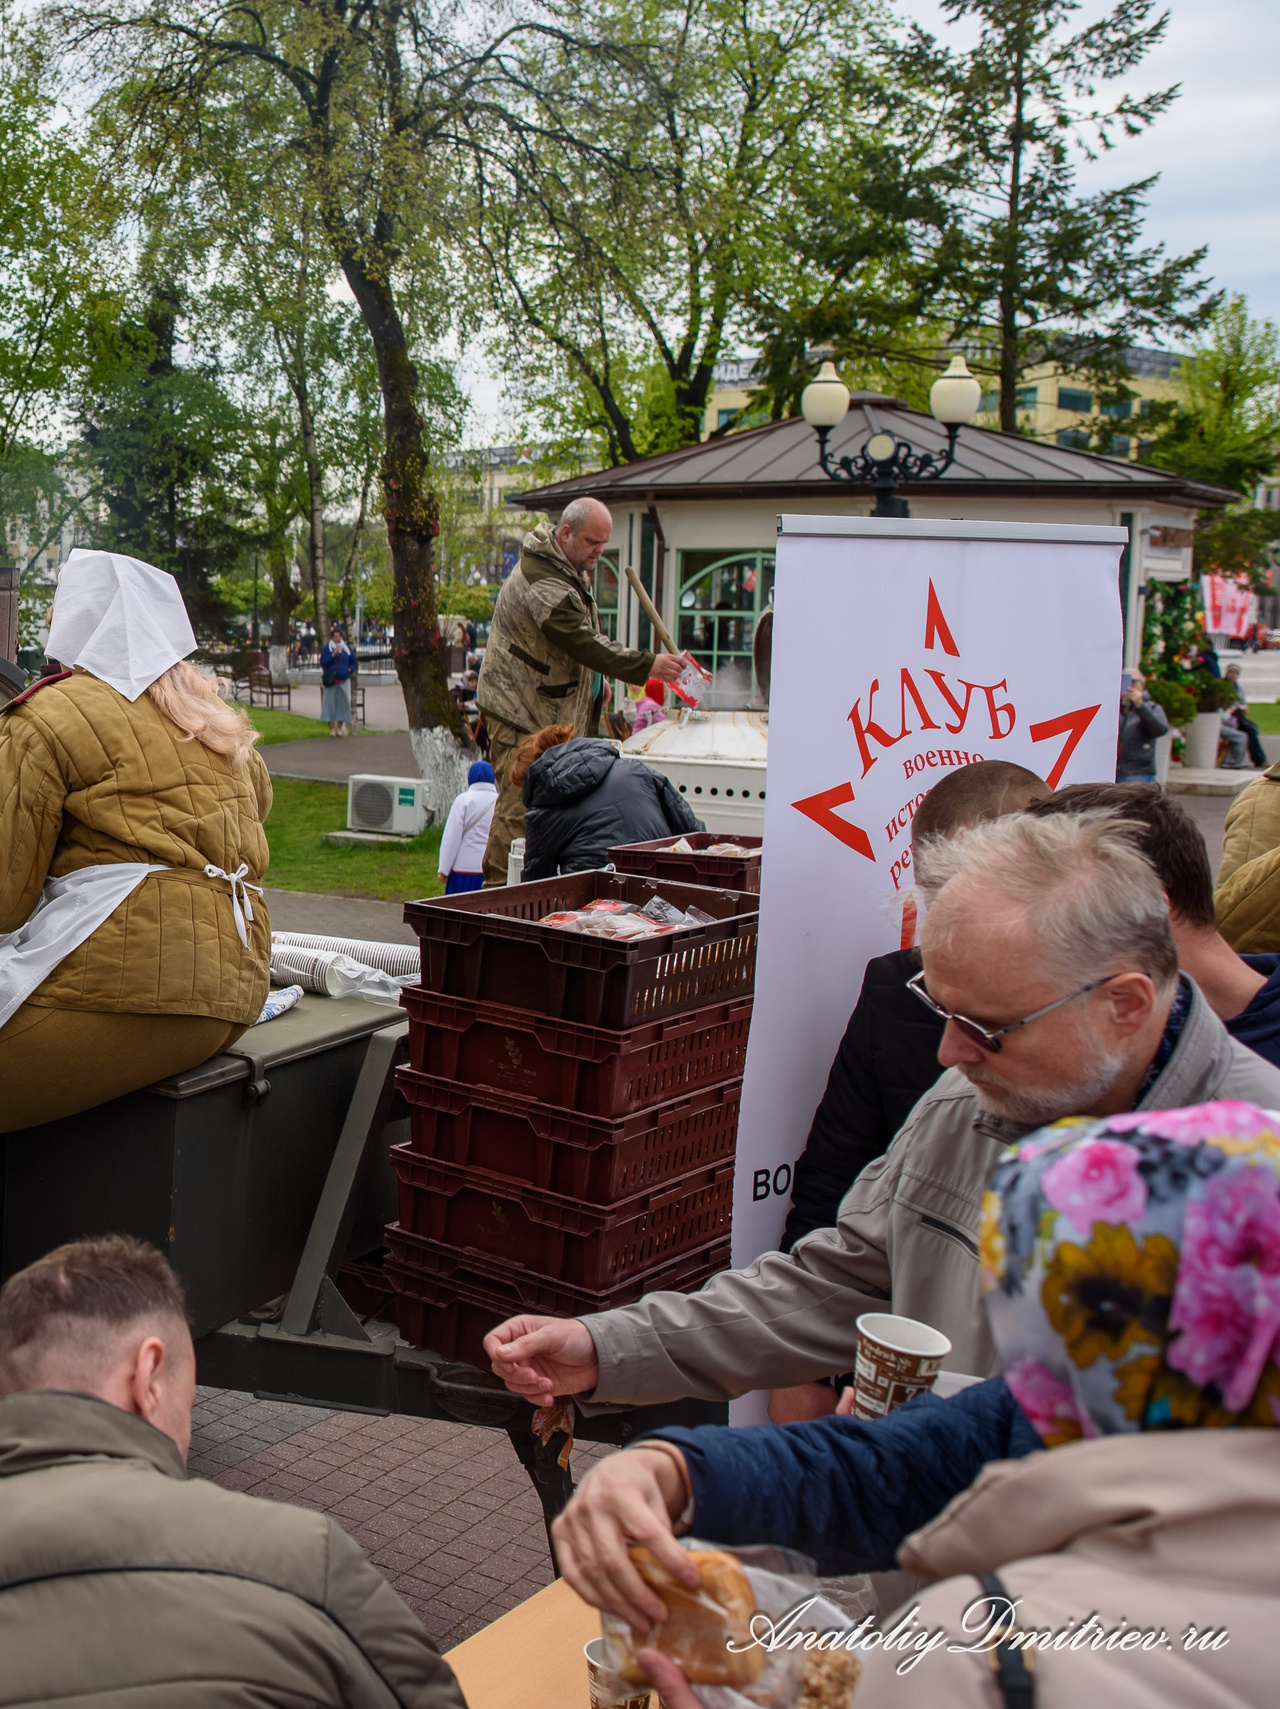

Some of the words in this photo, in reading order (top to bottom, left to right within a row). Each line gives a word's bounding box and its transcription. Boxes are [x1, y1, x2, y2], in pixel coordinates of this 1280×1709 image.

[846, 667, 1016, 780] КЛУБ
[884, 788, 932, 843] исто
[889, 844, 914, 891] ре
[752, 1162, 794, 1202] ВО
